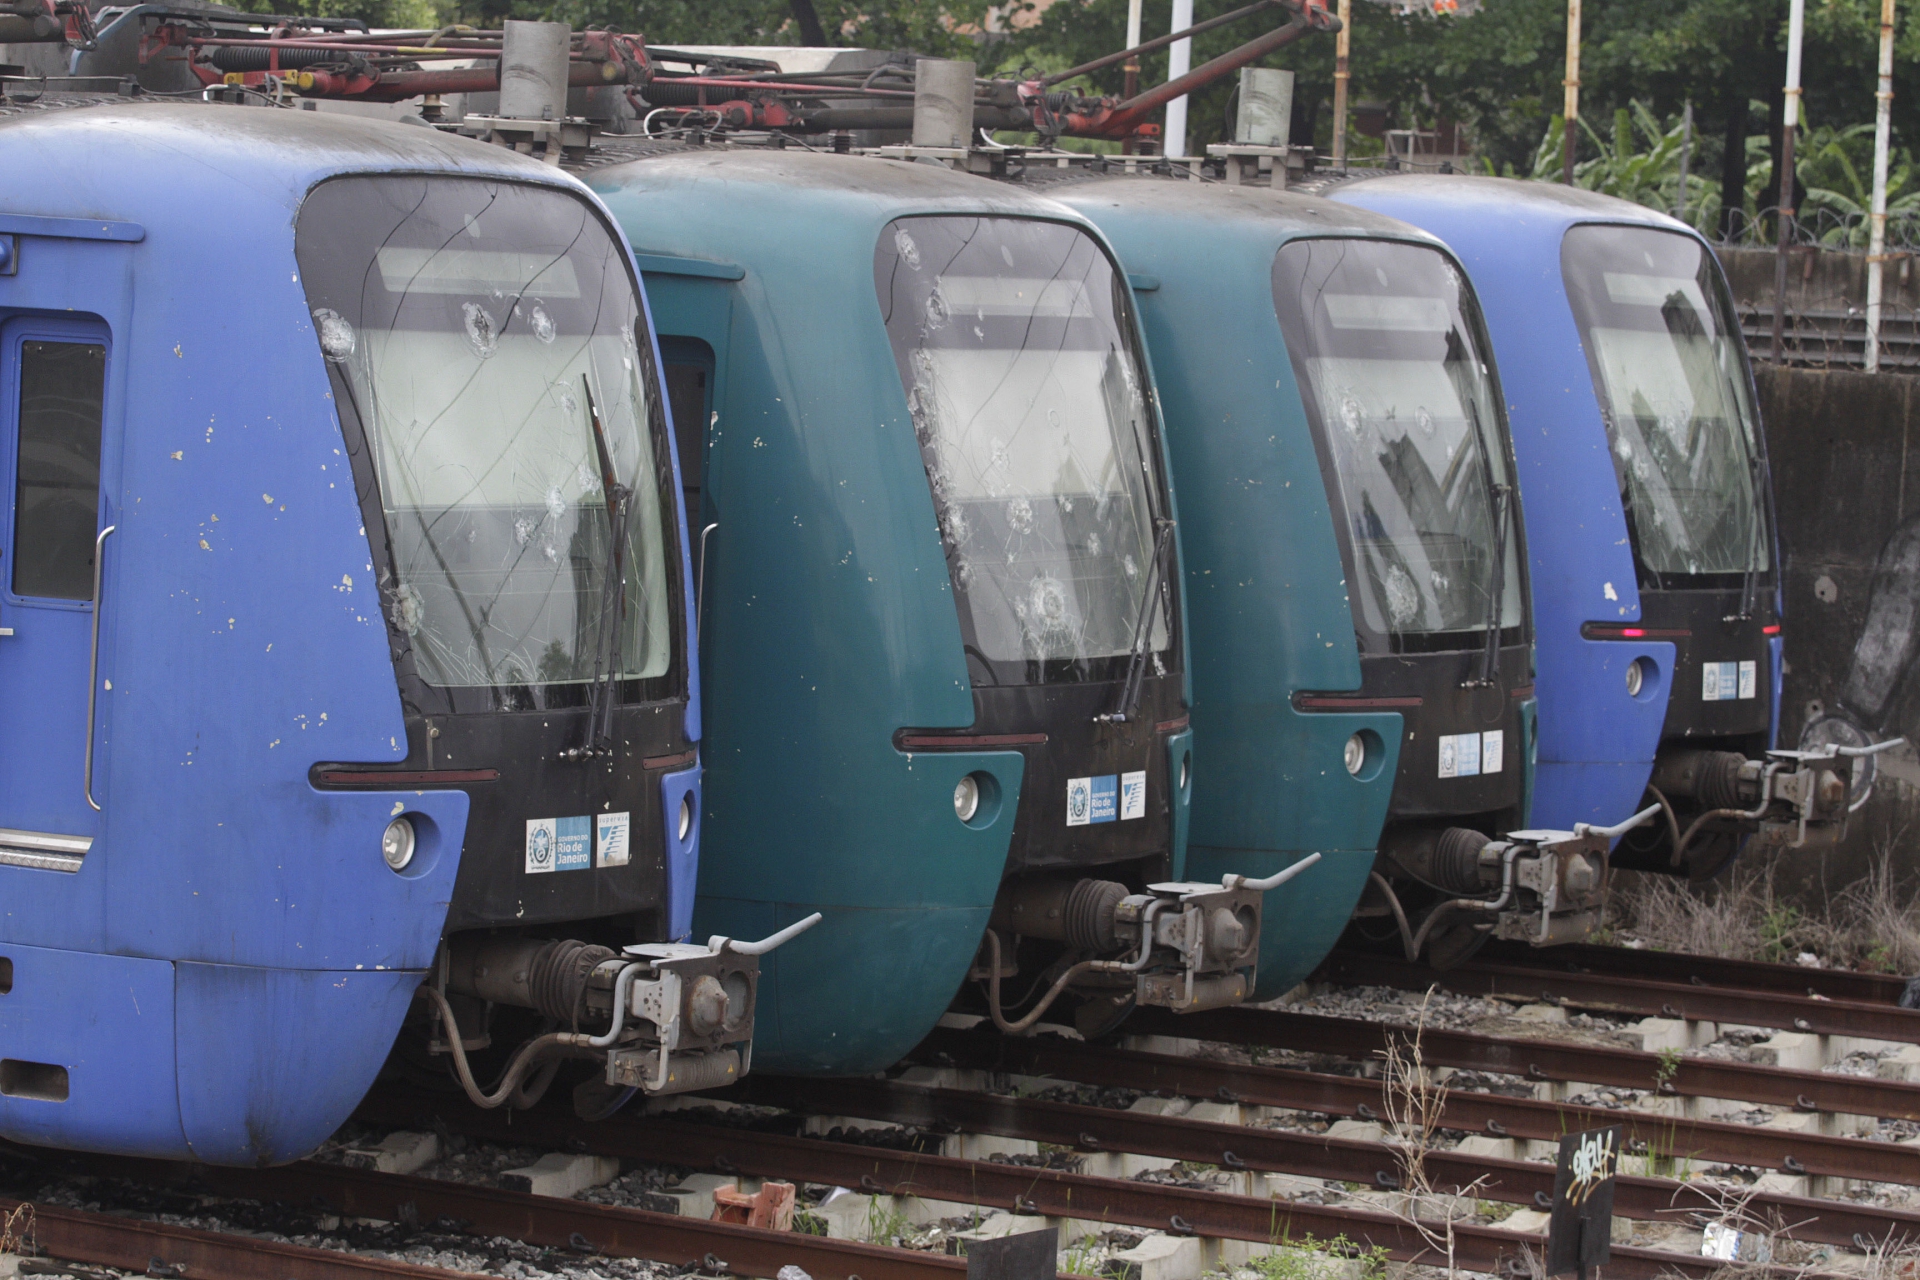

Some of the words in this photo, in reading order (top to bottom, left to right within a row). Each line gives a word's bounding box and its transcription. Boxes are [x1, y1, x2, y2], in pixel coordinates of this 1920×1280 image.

[1091, 798, 1102, 808] Rio
[1103, 797, 1111, 806] de
[1091, 808, 1115, 818] Janeiro
[558, 835, 580, 843] GOVERNO
[557, 843, 571, 853] Rio
[572, 841, 583, 852] de
[557, 852, 588, 864] Janeiro
